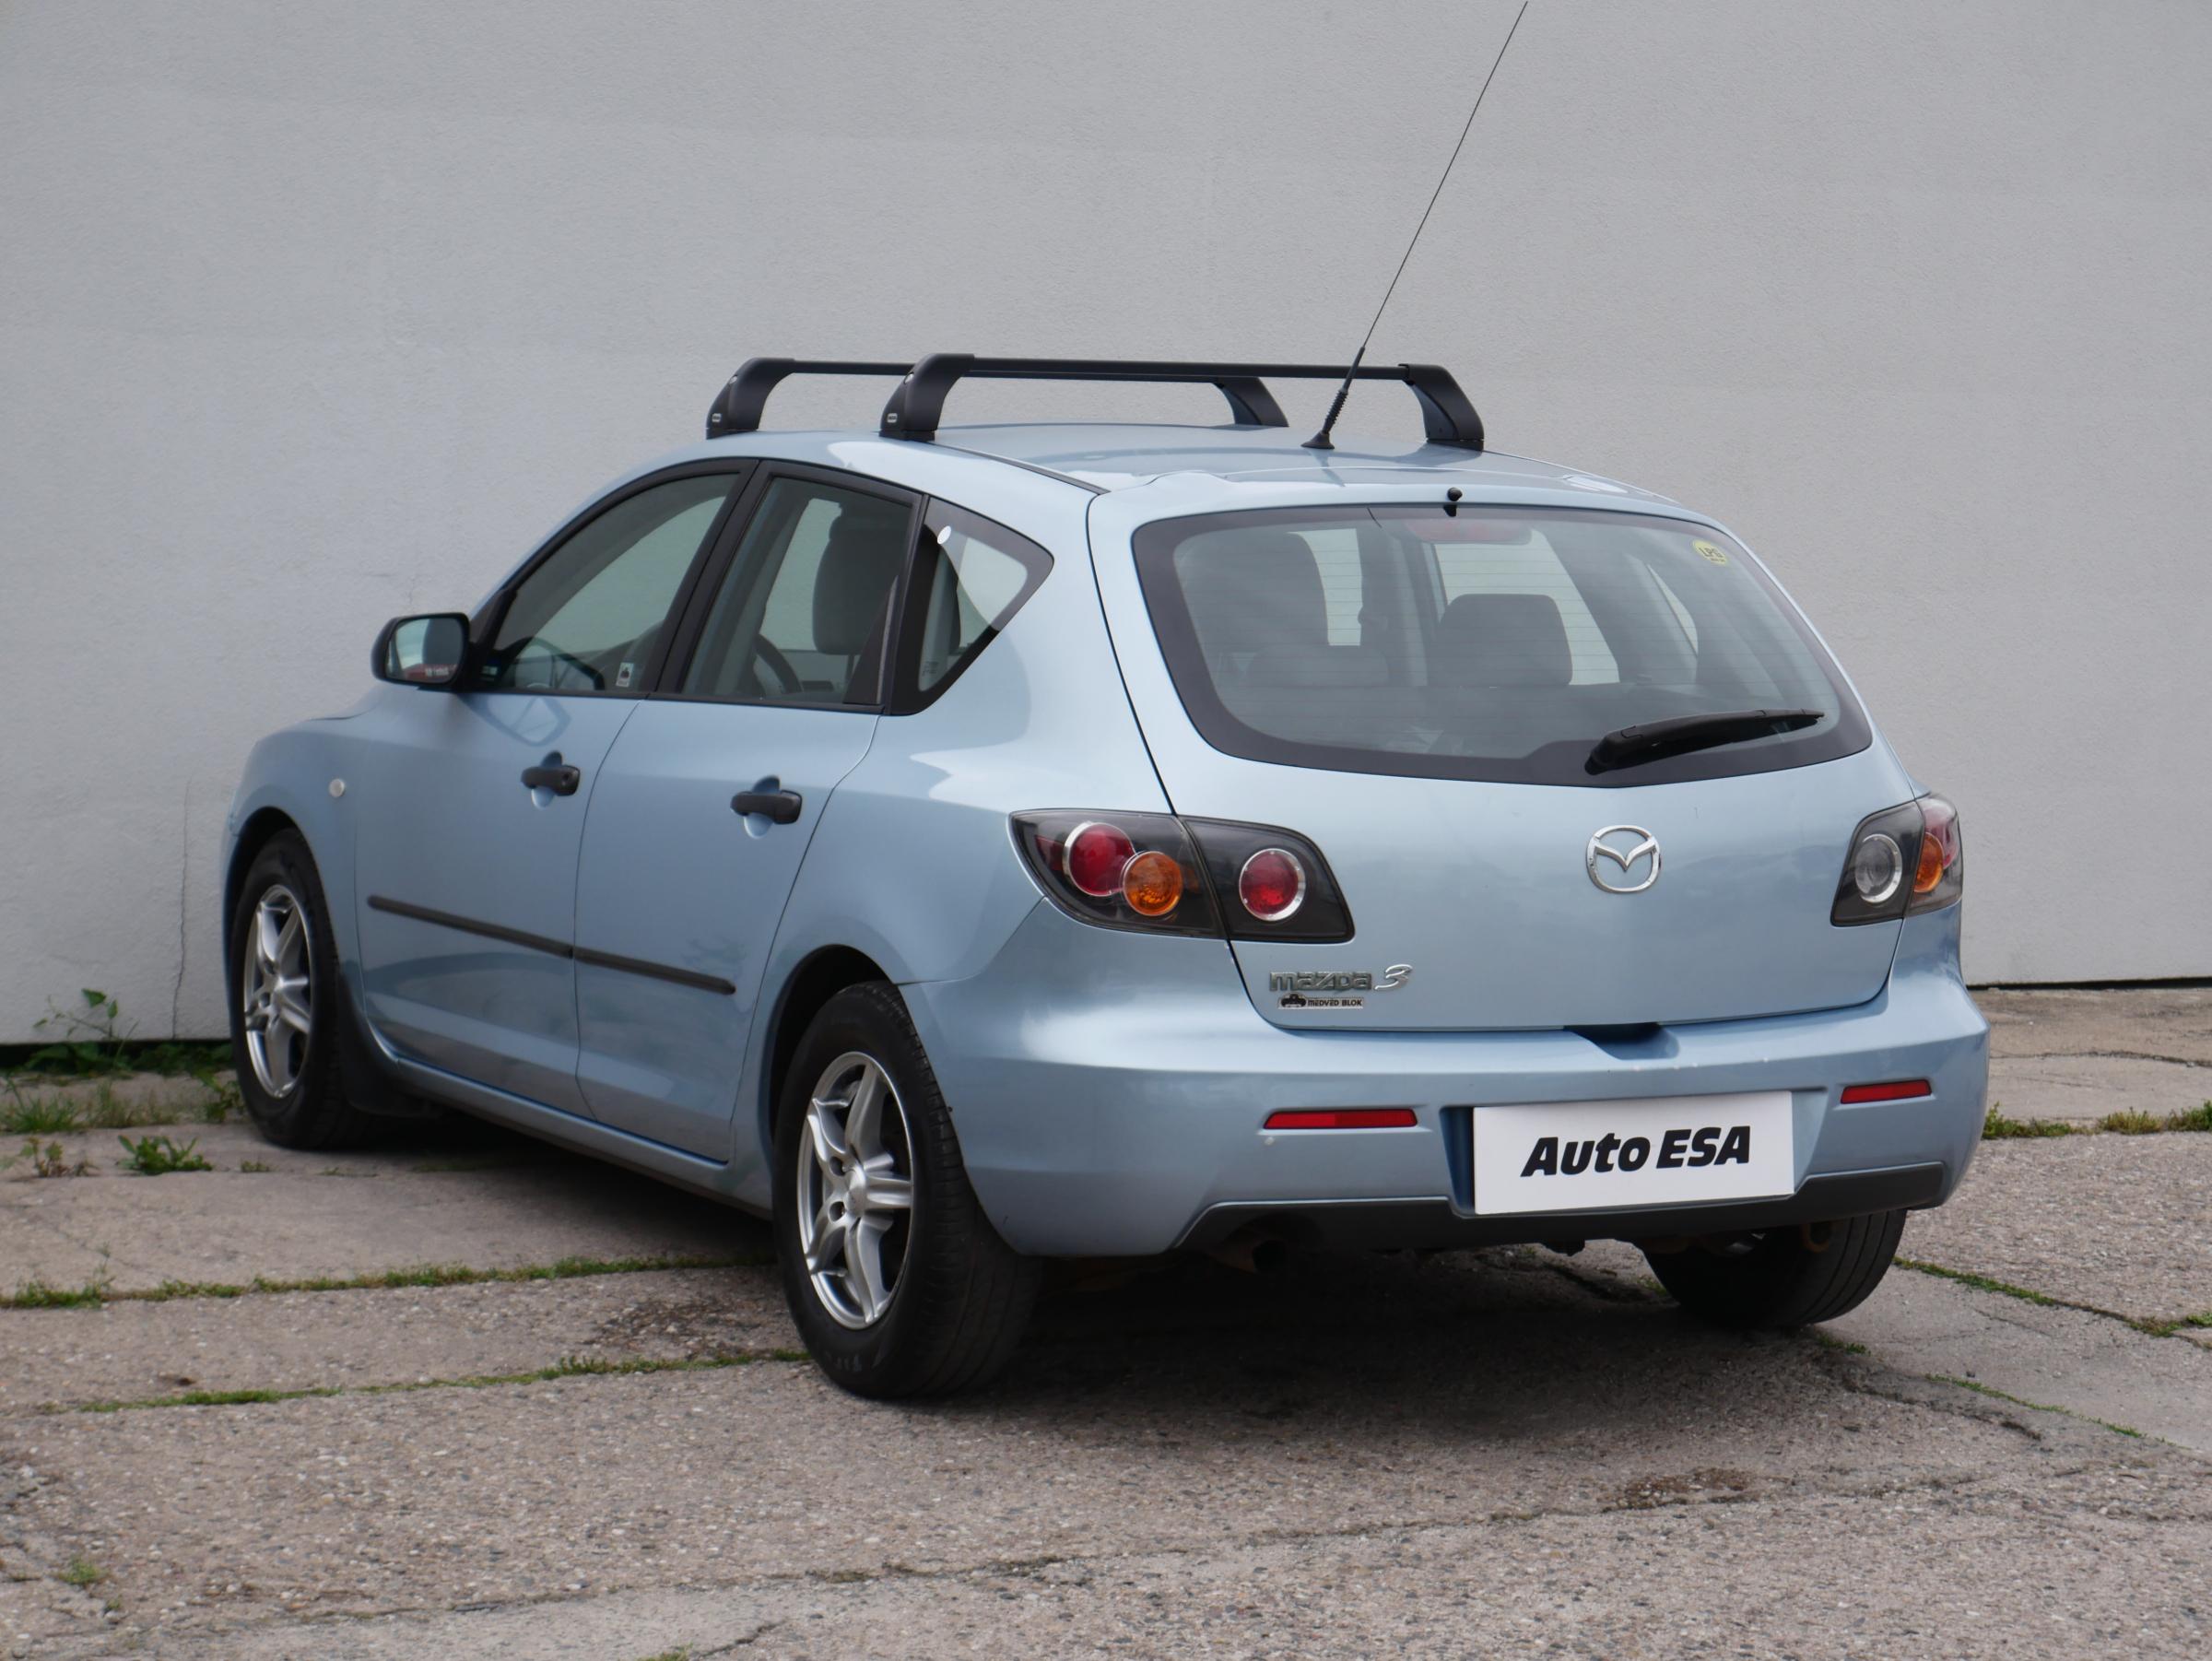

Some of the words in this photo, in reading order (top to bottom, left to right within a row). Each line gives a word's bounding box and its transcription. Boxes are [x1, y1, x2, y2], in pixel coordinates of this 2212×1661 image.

[1269, 972, 1372, 992] mazda
[1374, 963, 1413, 990] 3
[1341, 998, 1363, 1007] BLOK
[1520, 1132, 1651, 1177] Auto
[1655, 1125, 1751, 1170] ESA
